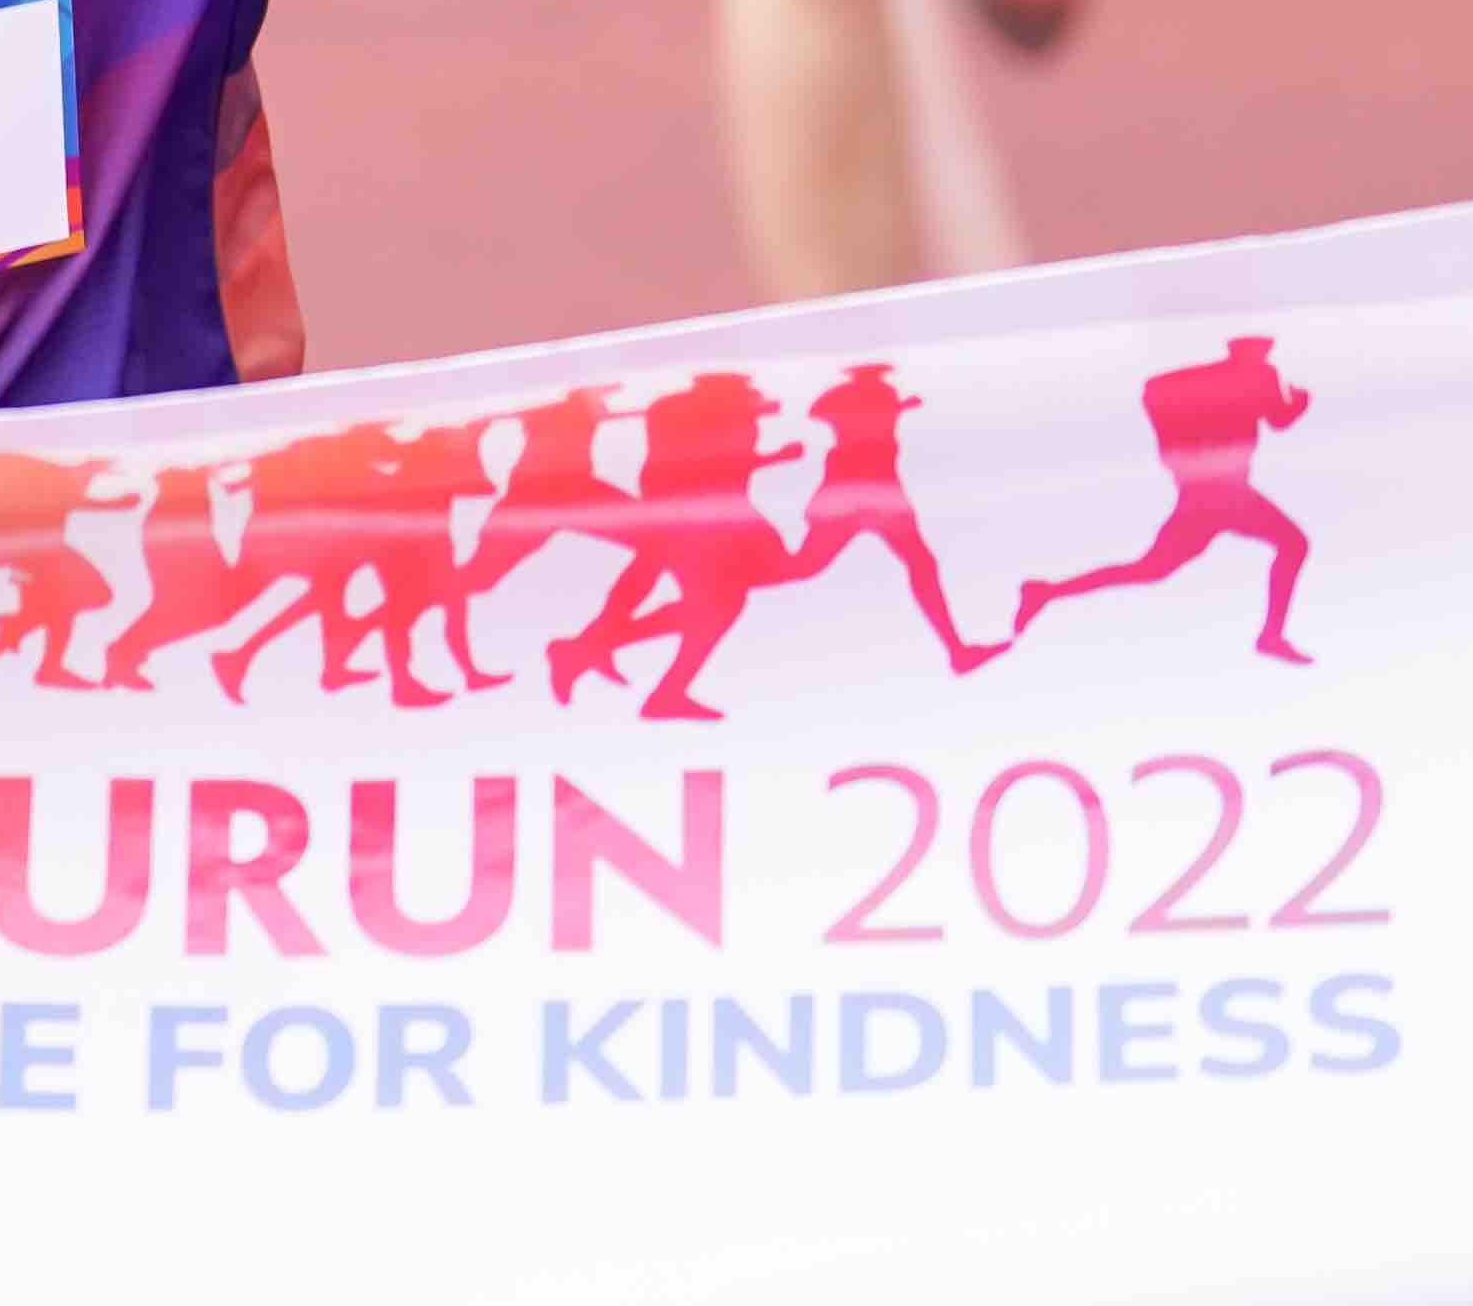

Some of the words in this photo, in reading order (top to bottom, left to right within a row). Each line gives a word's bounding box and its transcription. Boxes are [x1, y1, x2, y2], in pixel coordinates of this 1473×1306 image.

[822, 748, 1392, 945] 2022
[145, 1001, 477, 1111] FOR
[540, 971, 1404, 1105] KINDNESS
